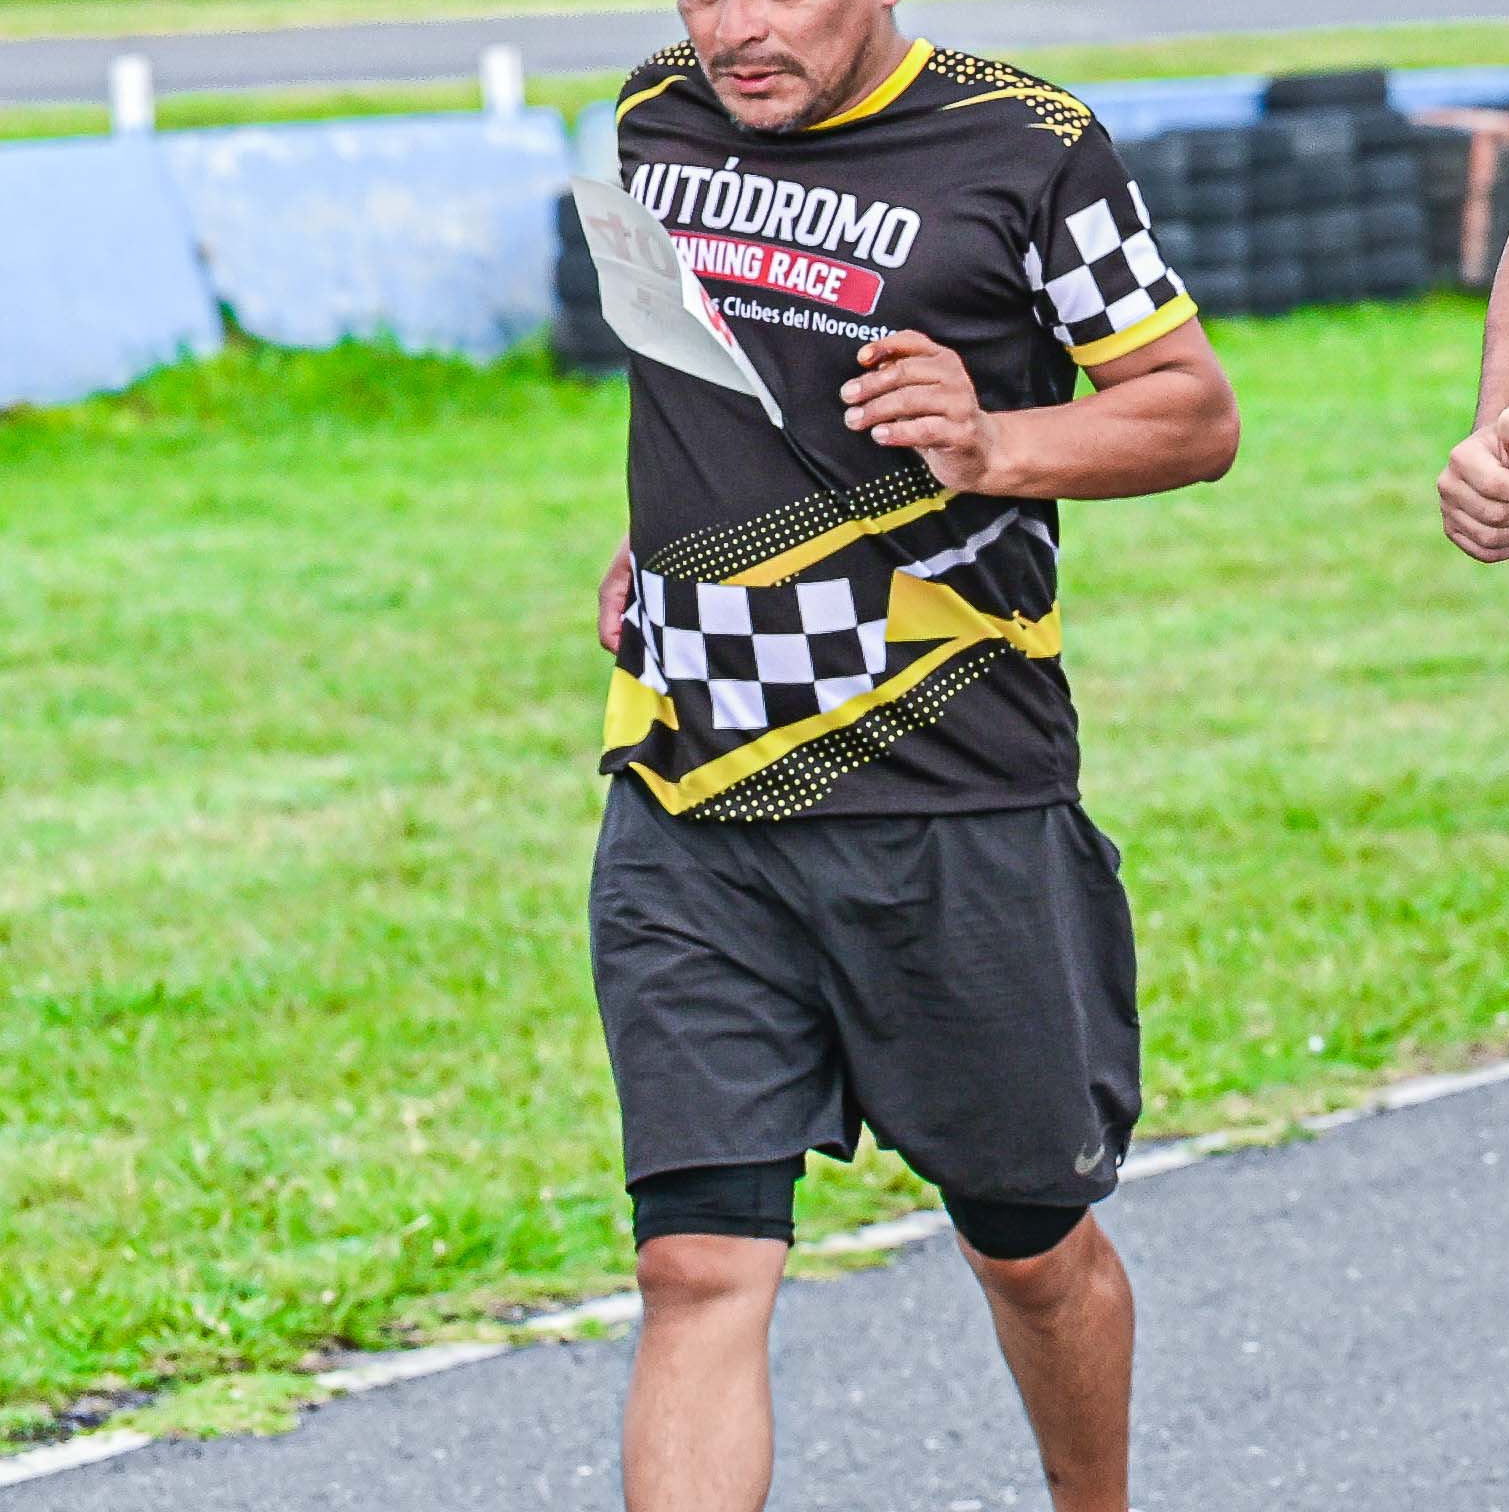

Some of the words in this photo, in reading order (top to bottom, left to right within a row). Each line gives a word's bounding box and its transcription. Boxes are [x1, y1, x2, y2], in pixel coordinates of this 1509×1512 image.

[767, 249, 847, 303] RACE
[723, 296, 780, 324] Clubes
[782, 307, 810, 329] del
